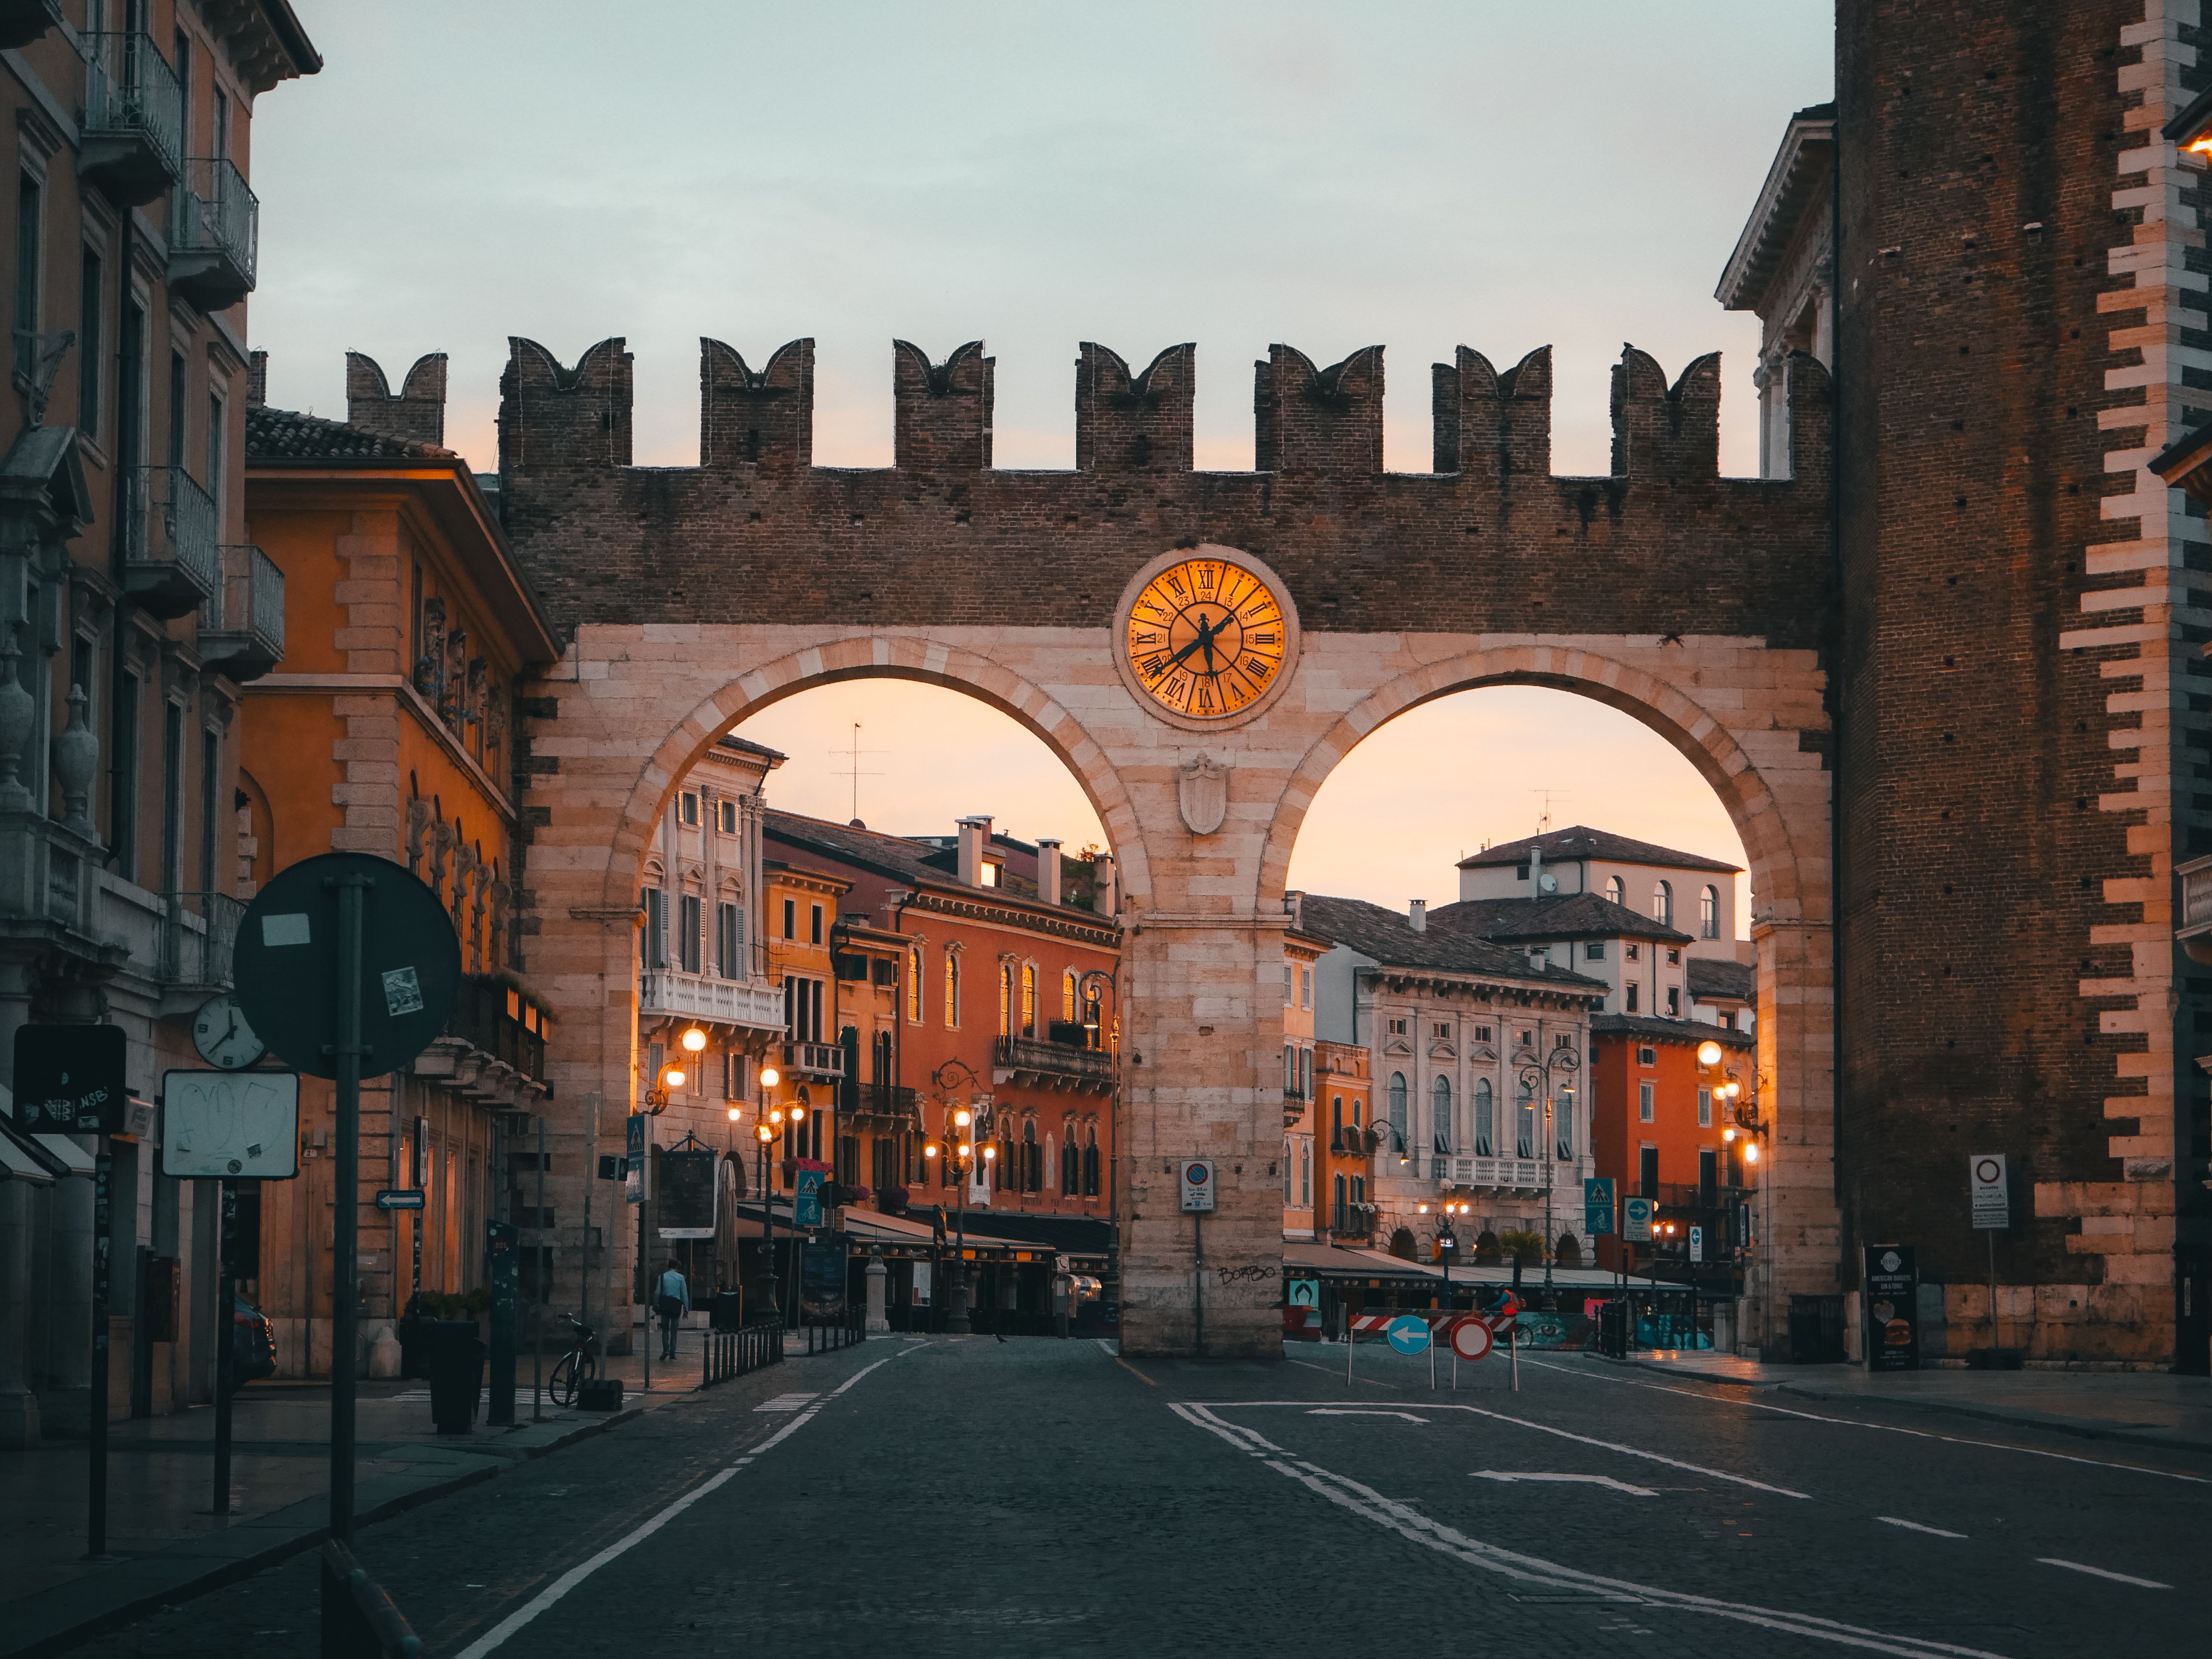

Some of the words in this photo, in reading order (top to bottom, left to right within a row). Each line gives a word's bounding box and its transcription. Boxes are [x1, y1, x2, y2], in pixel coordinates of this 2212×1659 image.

[1198, 570, 1214, 589] XII
[1167, 576, 1186, 598] XI
[1229, 579, 1241, 597] I
[1201, 591, 1212, 601] 24
[1178, 597, 1190, 606] 23
[1225, 598, 1233, 607] 13
[1144, 601, 1165, 616] X
[1248, 602, 1268, 617] II
[1163, 612, 1174, 621] 22
[1240, 612, 1249, 621] 14
[1137, 632, 1156, 644] IX
[1157, 634, 1166, 643] 21
[1246, 634, 1254, 644] 15
[1255, 633, 1275, 645] III
[1240, 656, 1249, 666] 16
[1246, 657, 1269, 679] IIII
[1179, 671, 1188, 681] 19
[1224, 673, 1232, 682] 17
[1202, 678, 1210, 687] 18
[1164, 677, 1186, 702] VII
[1230, 682, 1246, 701] V
[1198, 688, 1214, 708] VI
[198, 1024, 208, 1033] 9
[223, 1056, 234, 1065] 6
